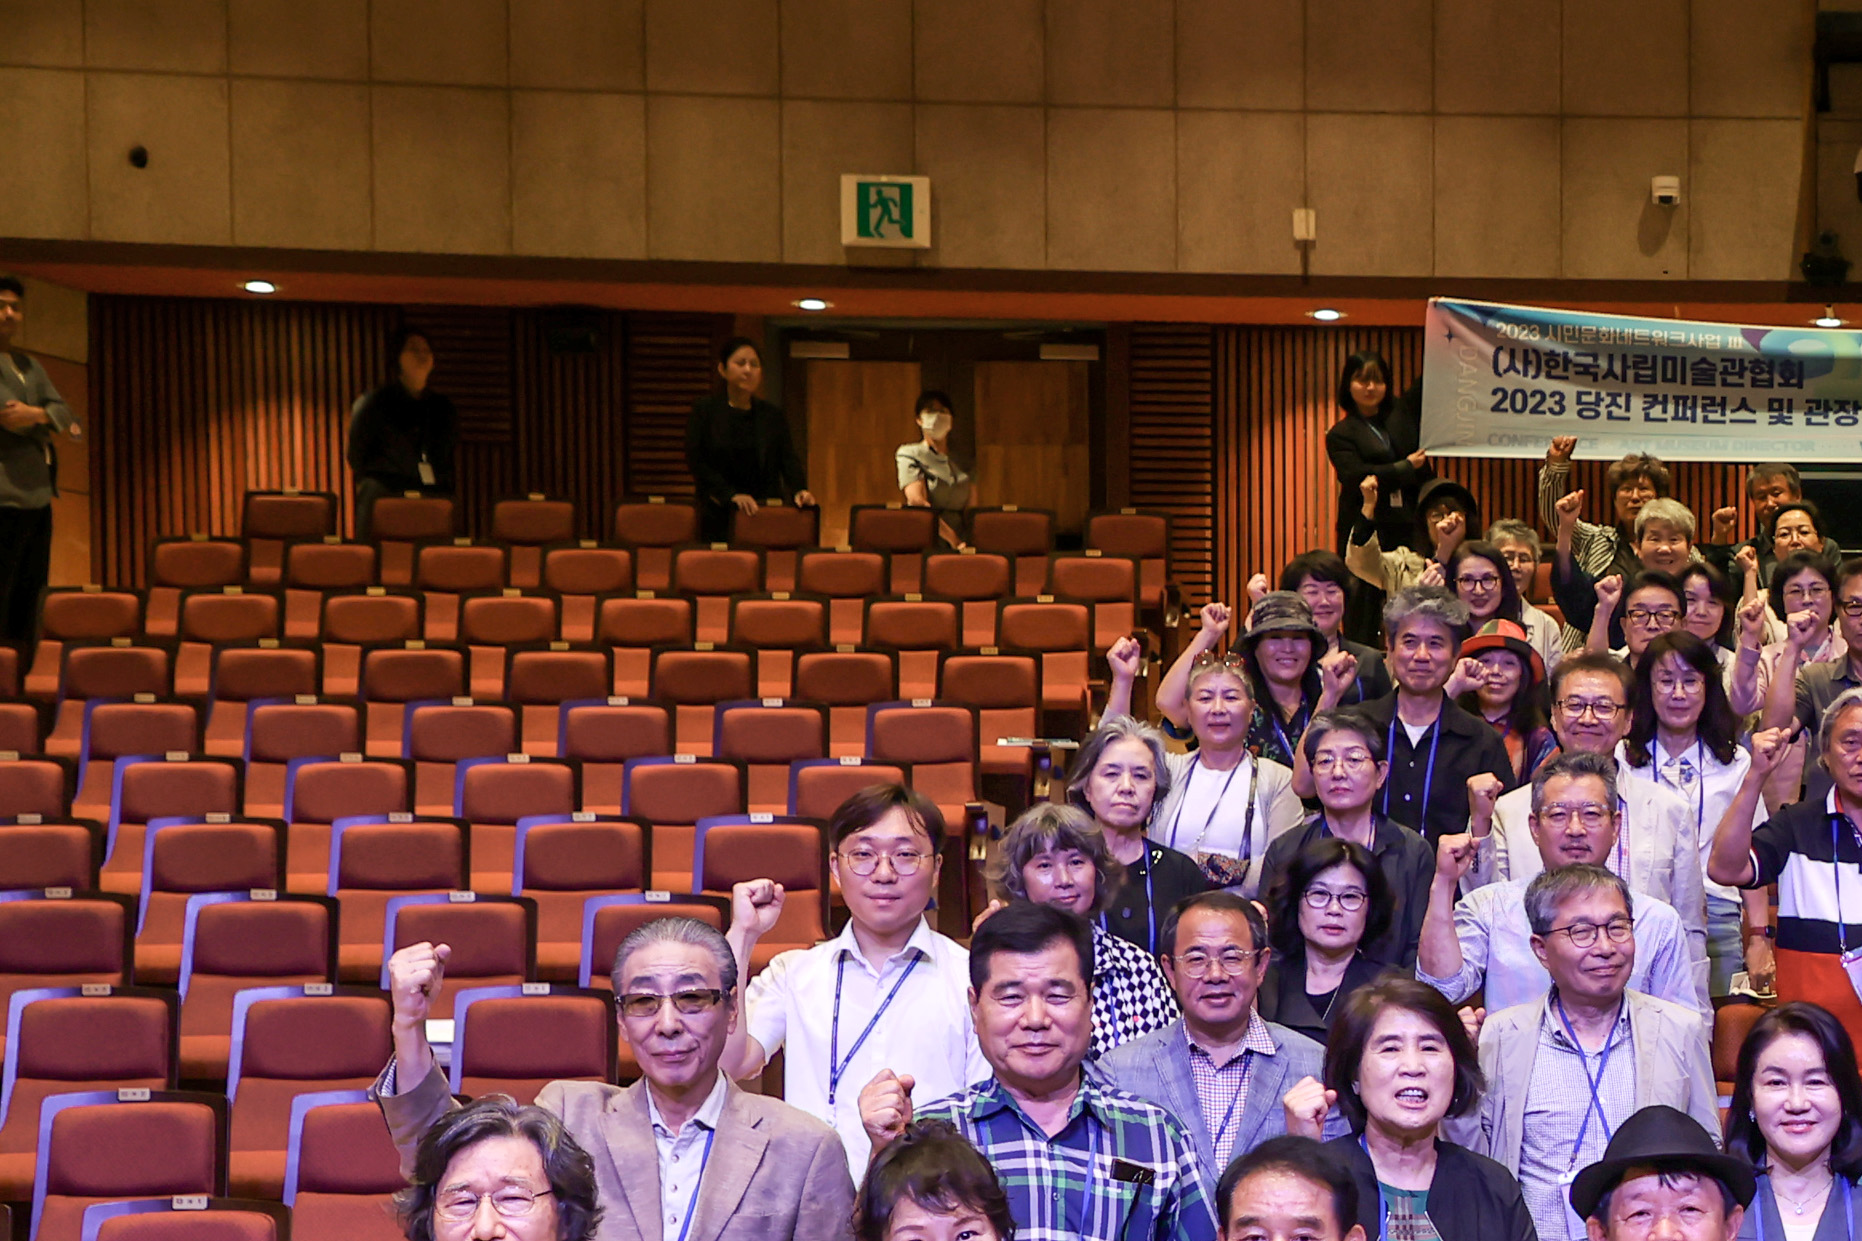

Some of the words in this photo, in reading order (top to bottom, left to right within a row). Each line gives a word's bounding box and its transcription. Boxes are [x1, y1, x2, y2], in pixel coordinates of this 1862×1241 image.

[1495, 322, 1540, 341] 2023
[1545, 324, 1721, 350] 시민문화네트워크사업
[1492, 346, 1804, 389] (사)한국사립미술관협회
[1490, 386, 1567, 416] 2023
[1575, 390, 1632, 422] 당진
[1641, 393, 1757, 425] 컨퍼런스
[1768, 397, 1794, 426] 및
[1804, 398, 1861, 427] 관장
